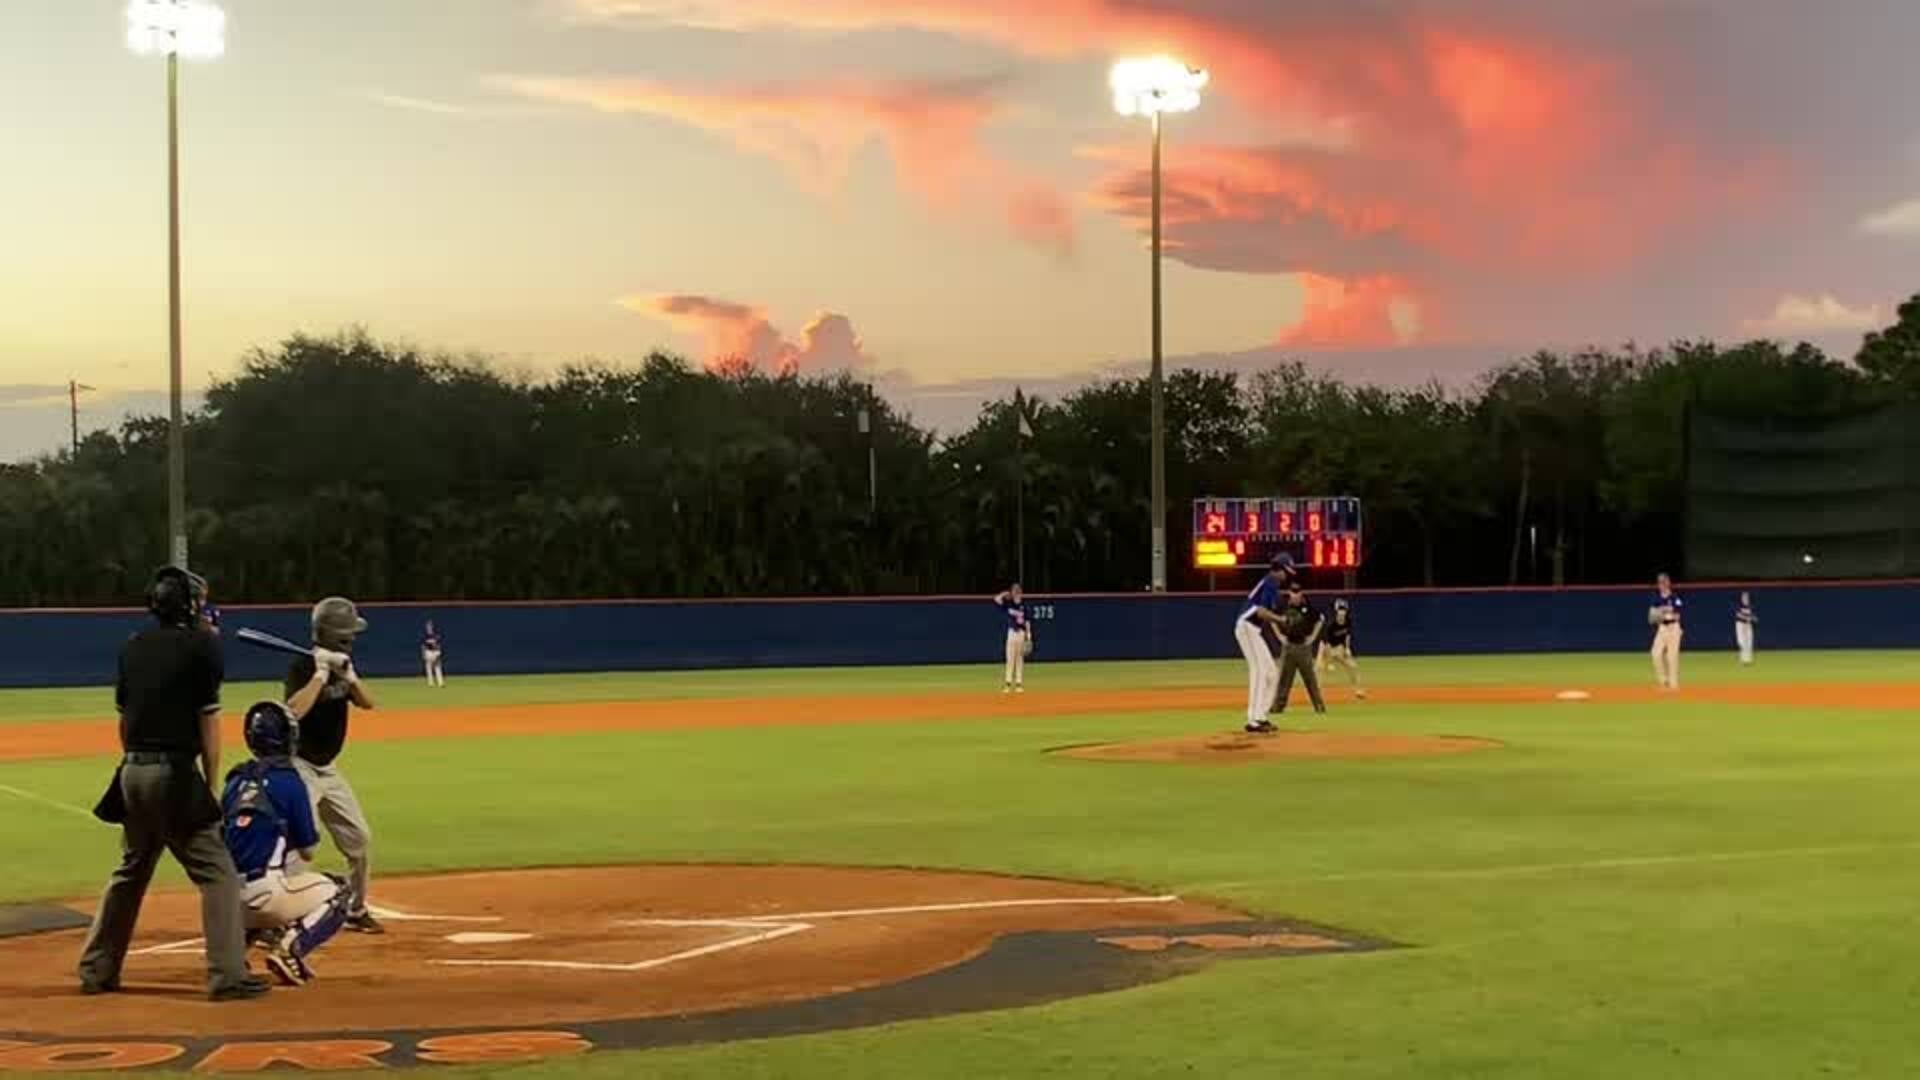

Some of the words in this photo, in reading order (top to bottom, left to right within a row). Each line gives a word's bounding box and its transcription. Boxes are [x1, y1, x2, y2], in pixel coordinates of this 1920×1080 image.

[1207, 514, 1226, 532] 24
[1248, 514, 1258, 533] 3
[1280, 513, 1291, 533] 2
[1309, 513, 1320, 532] 0
[1033, 605, 1054, 619] 375
